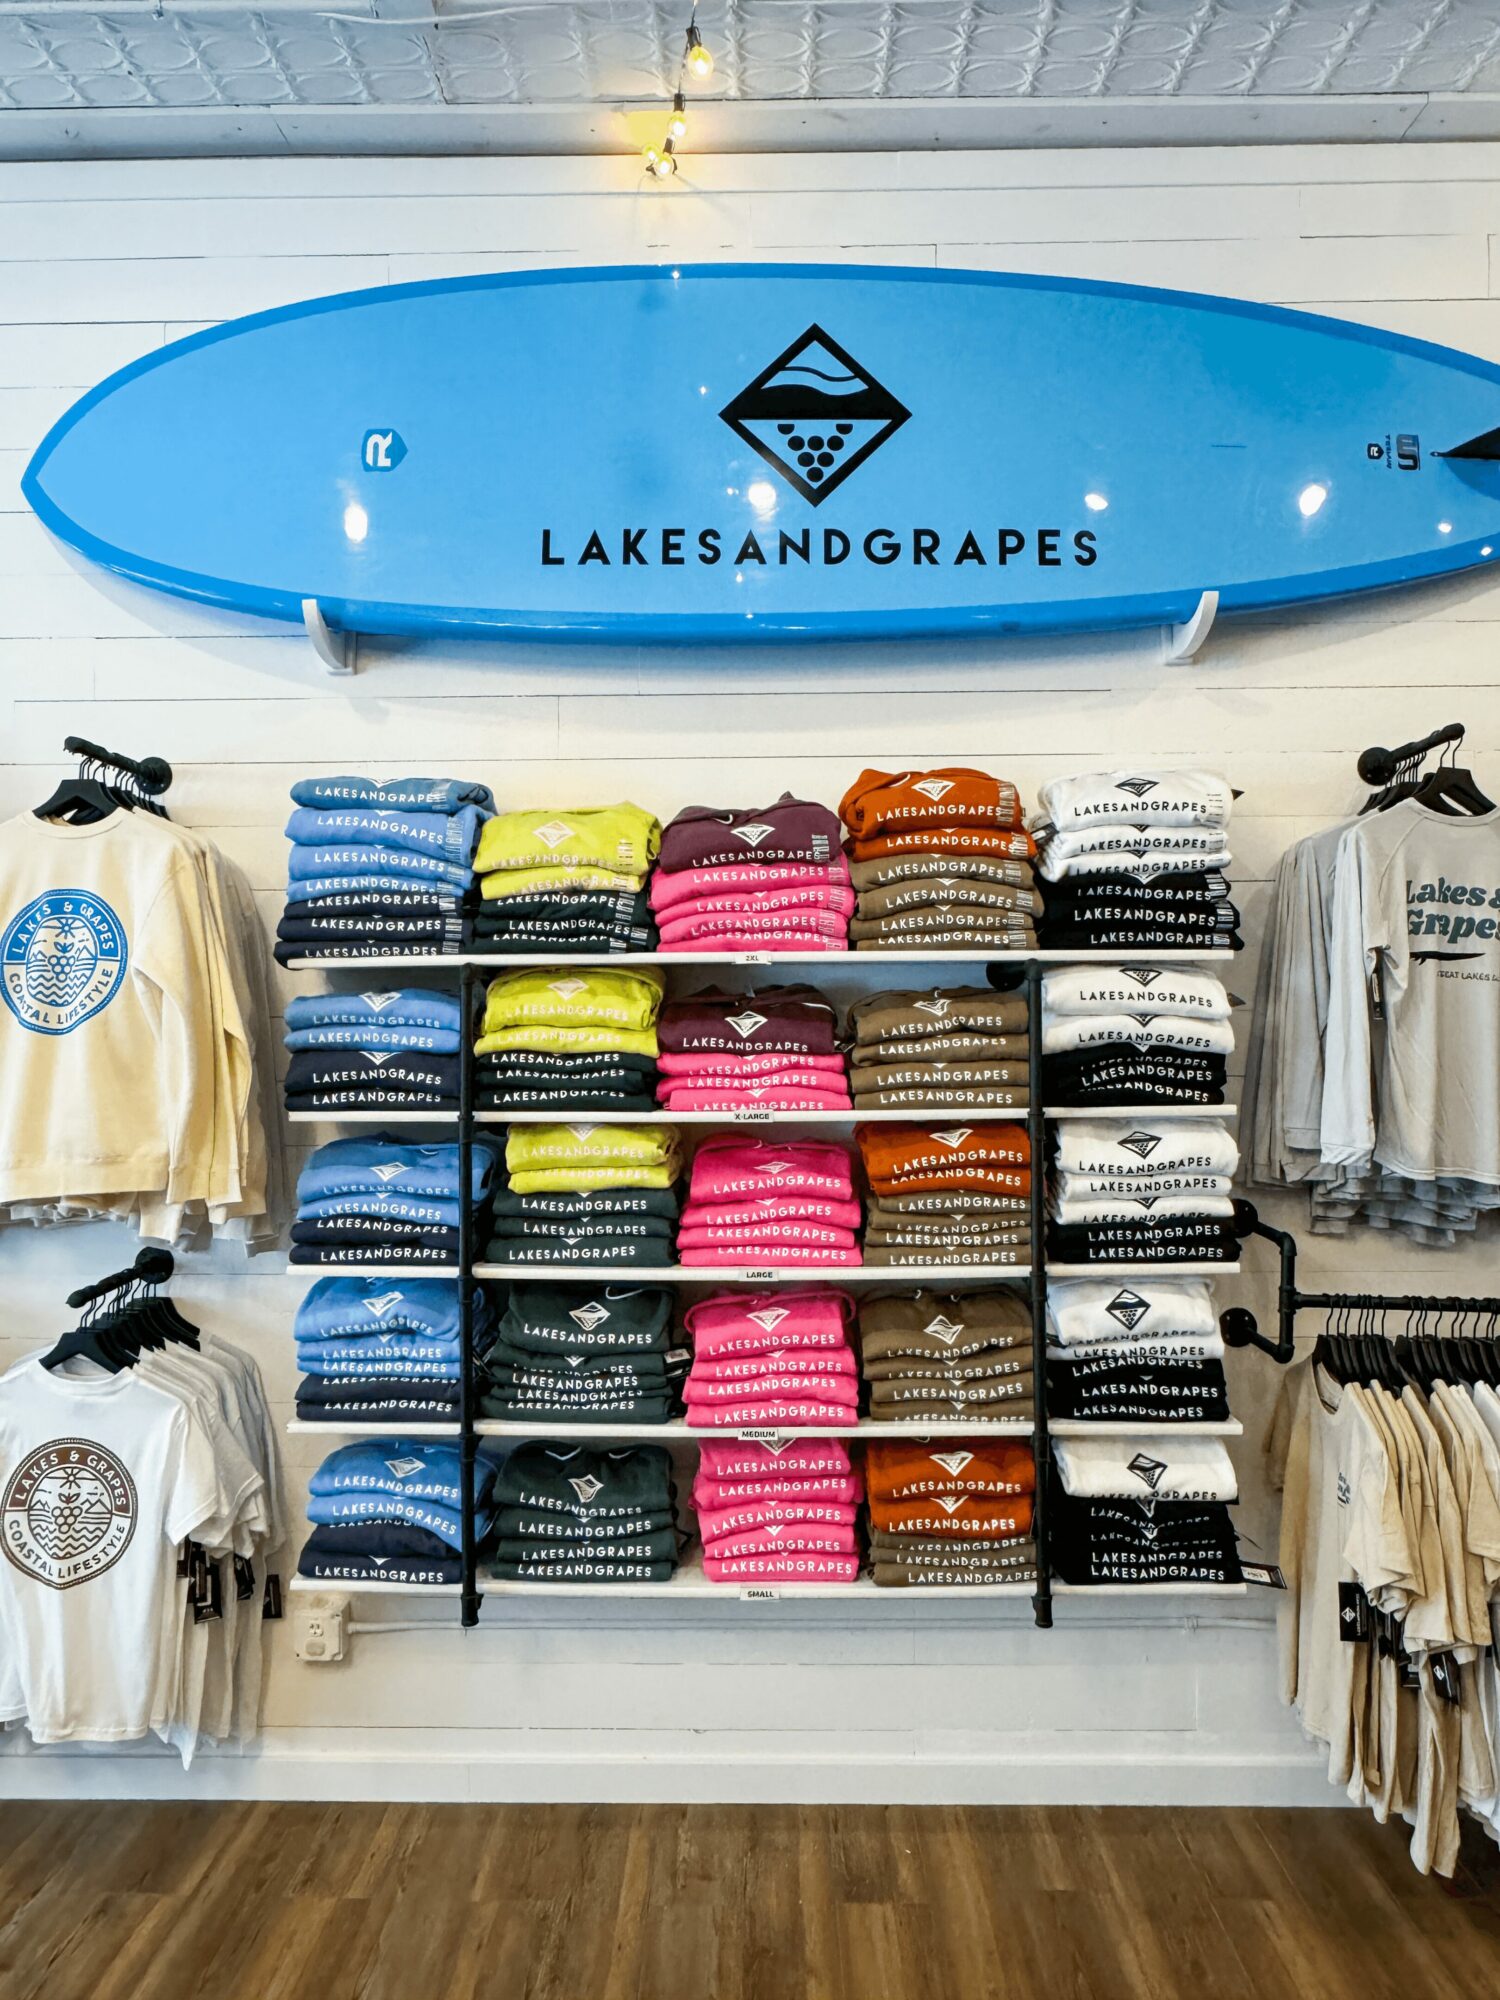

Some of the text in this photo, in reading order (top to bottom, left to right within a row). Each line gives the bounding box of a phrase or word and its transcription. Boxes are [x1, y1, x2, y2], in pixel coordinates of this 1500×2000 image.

[542, 528, 1097, 566] LAKESANDGRAPES
[316, 786, 436, 804] LAKESANDGRAPE
[877, 804, 1001, 822] LAKESANDGRAPES
[1075, 801, 1207, 817] LAKESANDGRAPES
[318, 816, 443, 845] LAKESANDGRAPES
[1080, 838, 1206, 852] LAKESANDGRAPES
[315, 852, 446, 872] LAKESANDGRAPES
[693, 850, 820, 867] LAKESANDGRAPES
[694, 867, 824, 883] LAKESANDGRAPES
[878, 862, 1003, 881] LAKESANDGRAPES
[886, 890, 1012, 909] LAKESANDGRAPES
[1406, 877, 1487, 906] Lakes
[308, 893, 438, 908] LAKESANDGRAPES
[697, 891, 825, 912] LAKESANDGRAPES
[312, 918, 441, 932] LAKESANDGRAPES
[1074, 908, 1216, 927] LAKESANDGRAPES
[12, 902, 114, 953] LAKES & GRAPES
[691, 917, 816, 936] LAKESANDGRAPES
[878, 932, 1009, 944] LAKESANDGRAPES
[1091, 932, 1212, 945] LAKESANDGRAPE
[57, 968, 113, 1024] LIFESTYLE
[1080, 991, 1212, 1008] LAKESANDGRAPES
[308, 1033, 433, 1047] LAKESANDGRAPES
[683, 1037, 808, 1052] LAKESANDGRAPES
[1079, 1031, 1211, 1048] LAKESANDGRAPES
[312, 1069, 442, 1084] LAKESANDGRAPES
[687, 1075, 817, 1088] LAKESANDGRAPES
[877, 1069, 1009, 1086] LAKESANDGRAPES
[1081, 1064, 1212, 1087] LAKESANDGRAPES
[312, 1092, 441, 1105] LAKESANDGRAPES
[880, 1091, 1013, 1104] LAKESANDGRAPES
[893, 1149, 1023, 1174] LAKESANDGRAPES
[1079, 1157, 1212, 1174] LAKESANDGRAPES
[713, 1175, 841, 1194] LAKESANDGRAPES
[1090, 1178, 1217, 1192] LAKESANDGRAPES
[319, 1203, 441, 1220] LAKESANDGRAPES
[522, 1198, 647, 1212] LAKESANDGRAPES
[899, 1197, 1026, 1212] LAKESANDGRAPES
[706, 1205, 832, 1225] LAKESANDGRAPES
[317, 1219, 448, 1234] LAKESANDGRAPES
[523, 1222, 646, 1236] LAKESANDGRAPES
[708, 1226, 836, 1242] LAKESANDGRAPES
[1088, 1225, 1221, 1242] LAKESANDGRAPES
[886, 1232, 1018, 1245] LAKESANDGRAPES
[321, 1248, 447, 1261] LAKESANDGRAPES
[509, 1246, 636, 1260] LAKESANDGRAPES
[890, 1252, 1016, 1265] LAKESANDGRAPES
[1089, 1246, 1223, 1259] LAKESANDGRAPES
[523, 1323, 652, 1344] LAKESANDGRAPES
[709, 1334, 836, 1355] LAKESANDGRAPES
[323, 1347, 442, 1360] LAKESANDGRAPES
[323, 1361, 447, 1373] LAKESANDGRAPES
[716, 1361, 842, 1377] LAKESANDGRAPES
[512, 1372, 639, 1390] LAKESANDGRAPES
[708, 1377, 836, 1395] LAKESANDGRAPES
[893, 1382, 1023, 1401] LAKESANDGRAPES
[1082, 1384, 1218, 1398] LAKESANDGRAPES
[324, 1400, 452, 1412] LAKESANDGRAPES
[715, 1406, 844, 1424] LAKESANDGRAPES
[717, 1459, 842, 1476] LAKESANDGRAPES
[15, 1450, 126, 1506] LAKES & GRAPES
[334, 1476, 458, 1498] LAKESANDGRAPES
[719, 1479, 847, 1497] LAKESANDGRAPES
[893, 1481, 1022, 1498] LAKESANDGRAPES
[333, 1503, 457, 1535] LAKESANDGRAPES
[712, 1508, 841, 1535] LAKESANDGRAPES
[889, 1519, 1016, 1532] LAKESANDGRAPES
[519, 1520, 652, 1537] LAKESANDGRAPES
[9, 1520, 125, 1578] COASTAL LIFESTYLE
[522, 1546, 652, 1561] LAKESANDGRAPES
[714, 1539, 840, 1559] LAKESANDGRAPES
[315, 1566, 444, 1582] LAKESANDGRAPES
[518, 1564, 652, 1577] LAKESANDGRAPES
[722, 1561, 852, 1574] LAKESANDGRAPES
[1091, 1565, 1225, 1581] LAKESANDGRAPES
